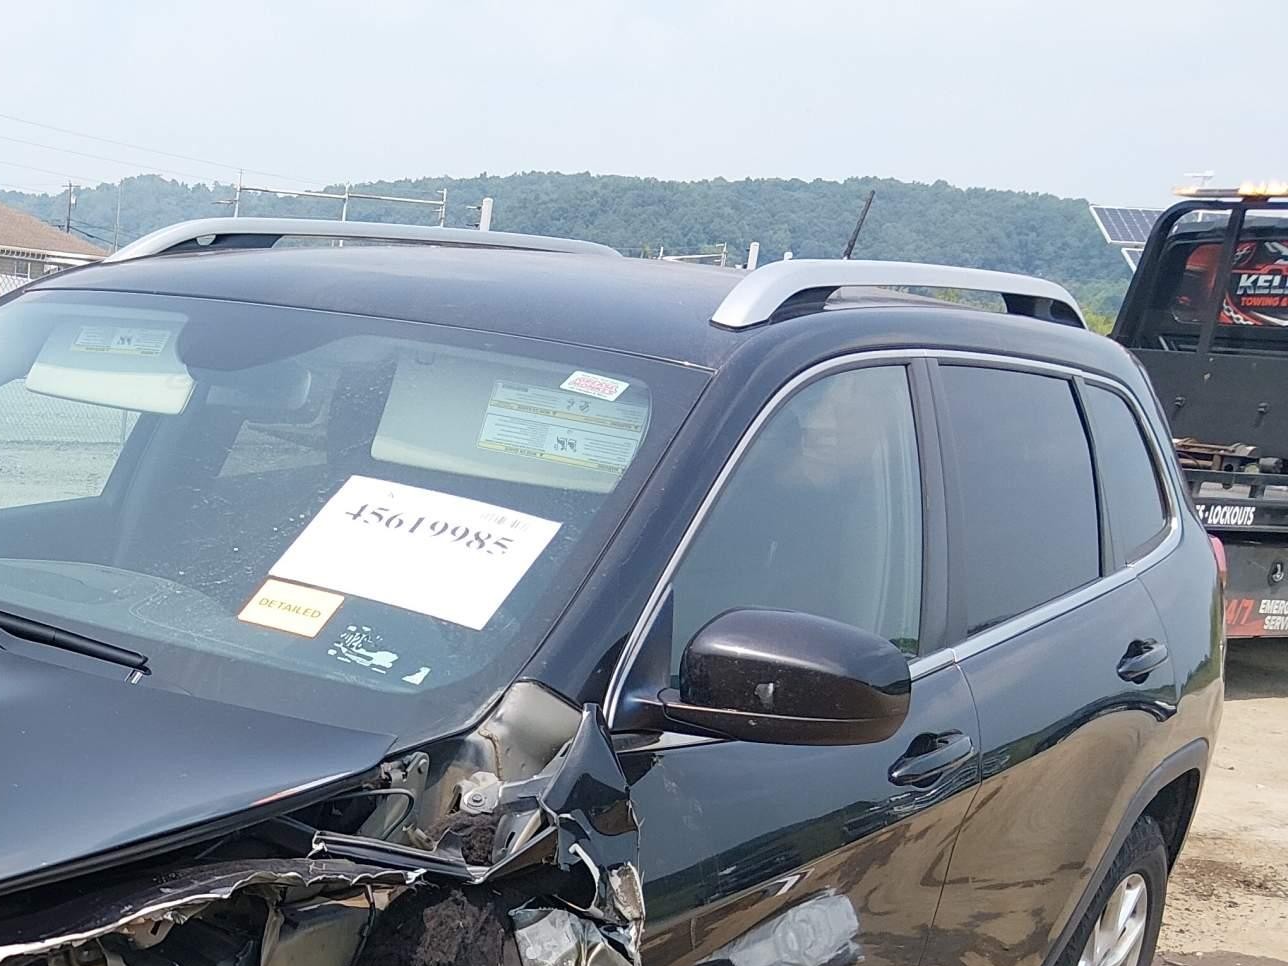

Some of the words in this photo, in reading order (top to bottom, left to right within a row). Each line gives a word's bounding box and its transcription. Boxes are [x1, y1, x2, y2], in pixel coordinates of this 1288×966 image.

[1240, 296, 1279, 306] TOWING
[1207, 505, 1256, 525] LOCKOUTS
[345, 503, 515, 556] 45619985
[258, 597, 321, 619] DETAILED
